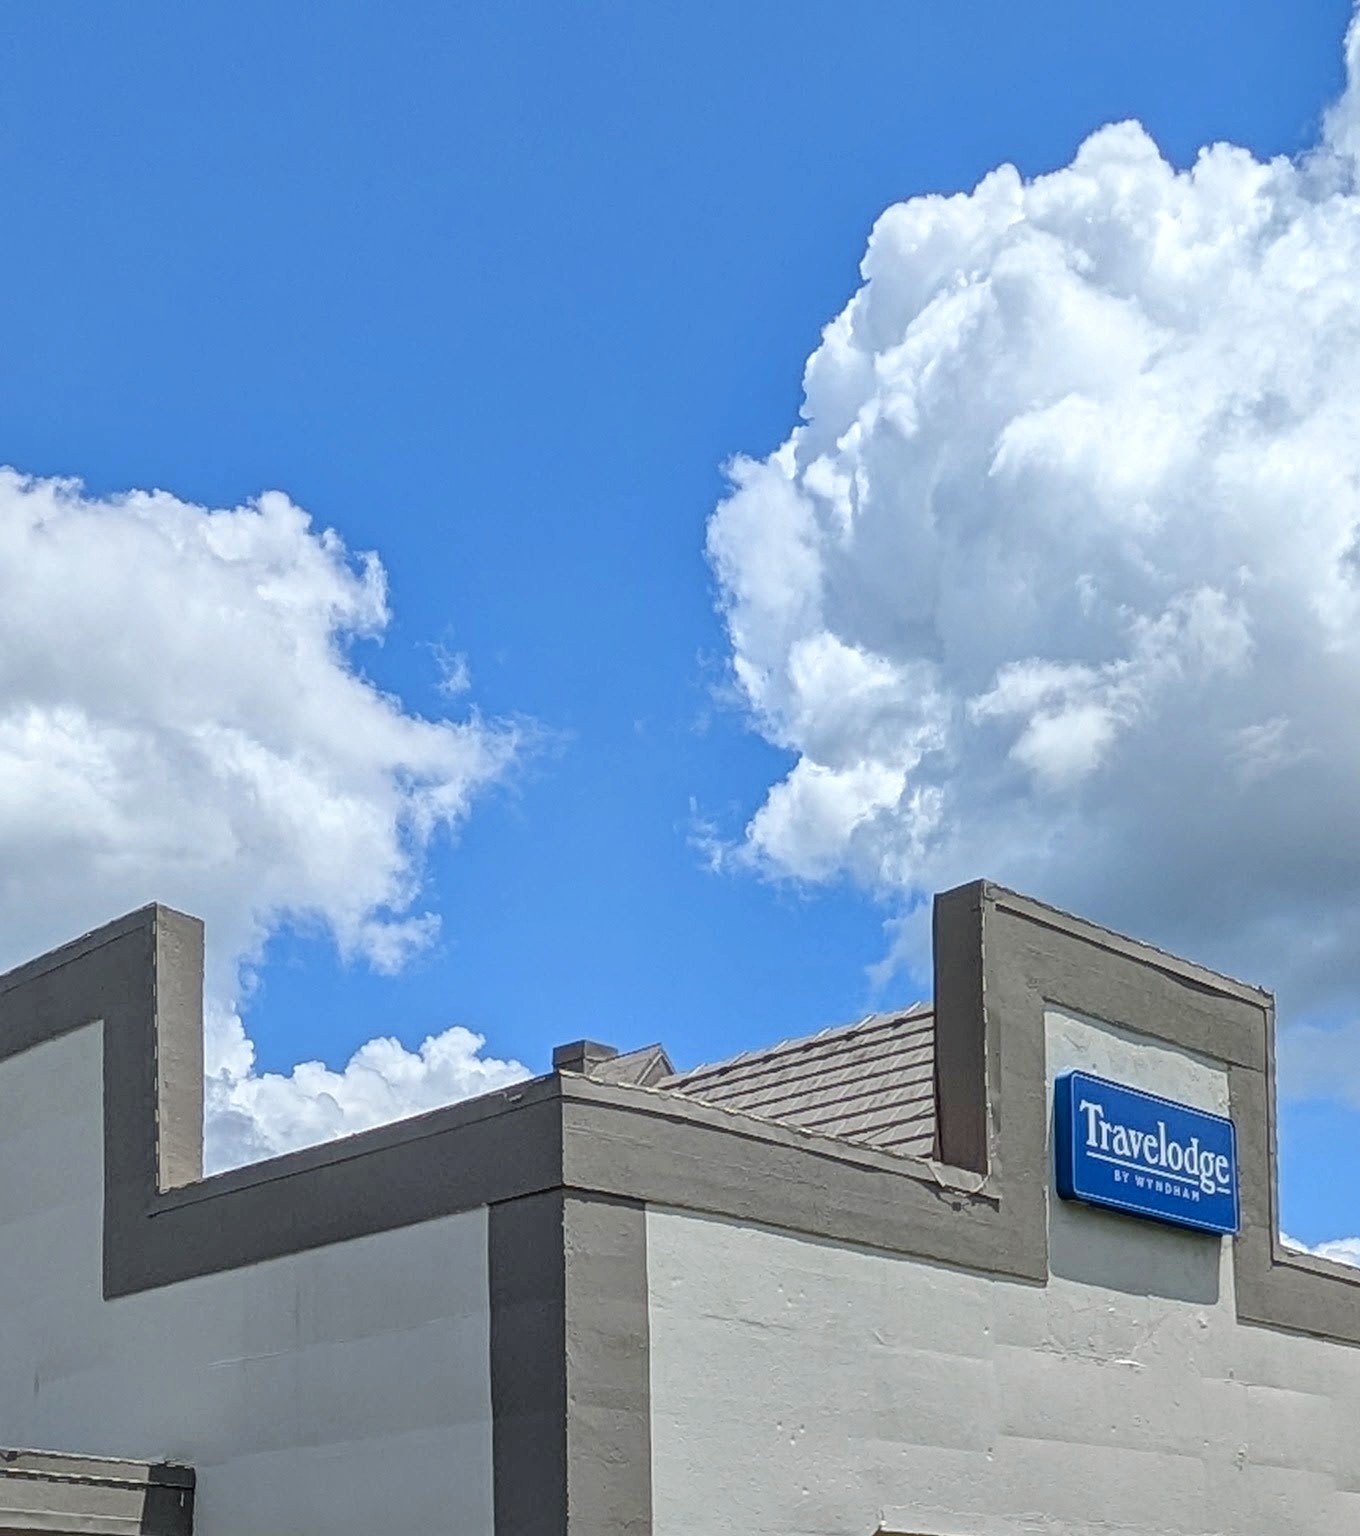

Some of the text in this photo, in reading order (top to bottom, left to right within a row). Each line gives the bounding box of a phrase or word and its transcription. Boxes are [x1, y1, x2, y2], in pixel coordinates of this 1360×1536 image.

[1079, 1099, 1230, 1193] Travelodge
[1114, 1170, 1201, 1202] BY WYNDHAM
